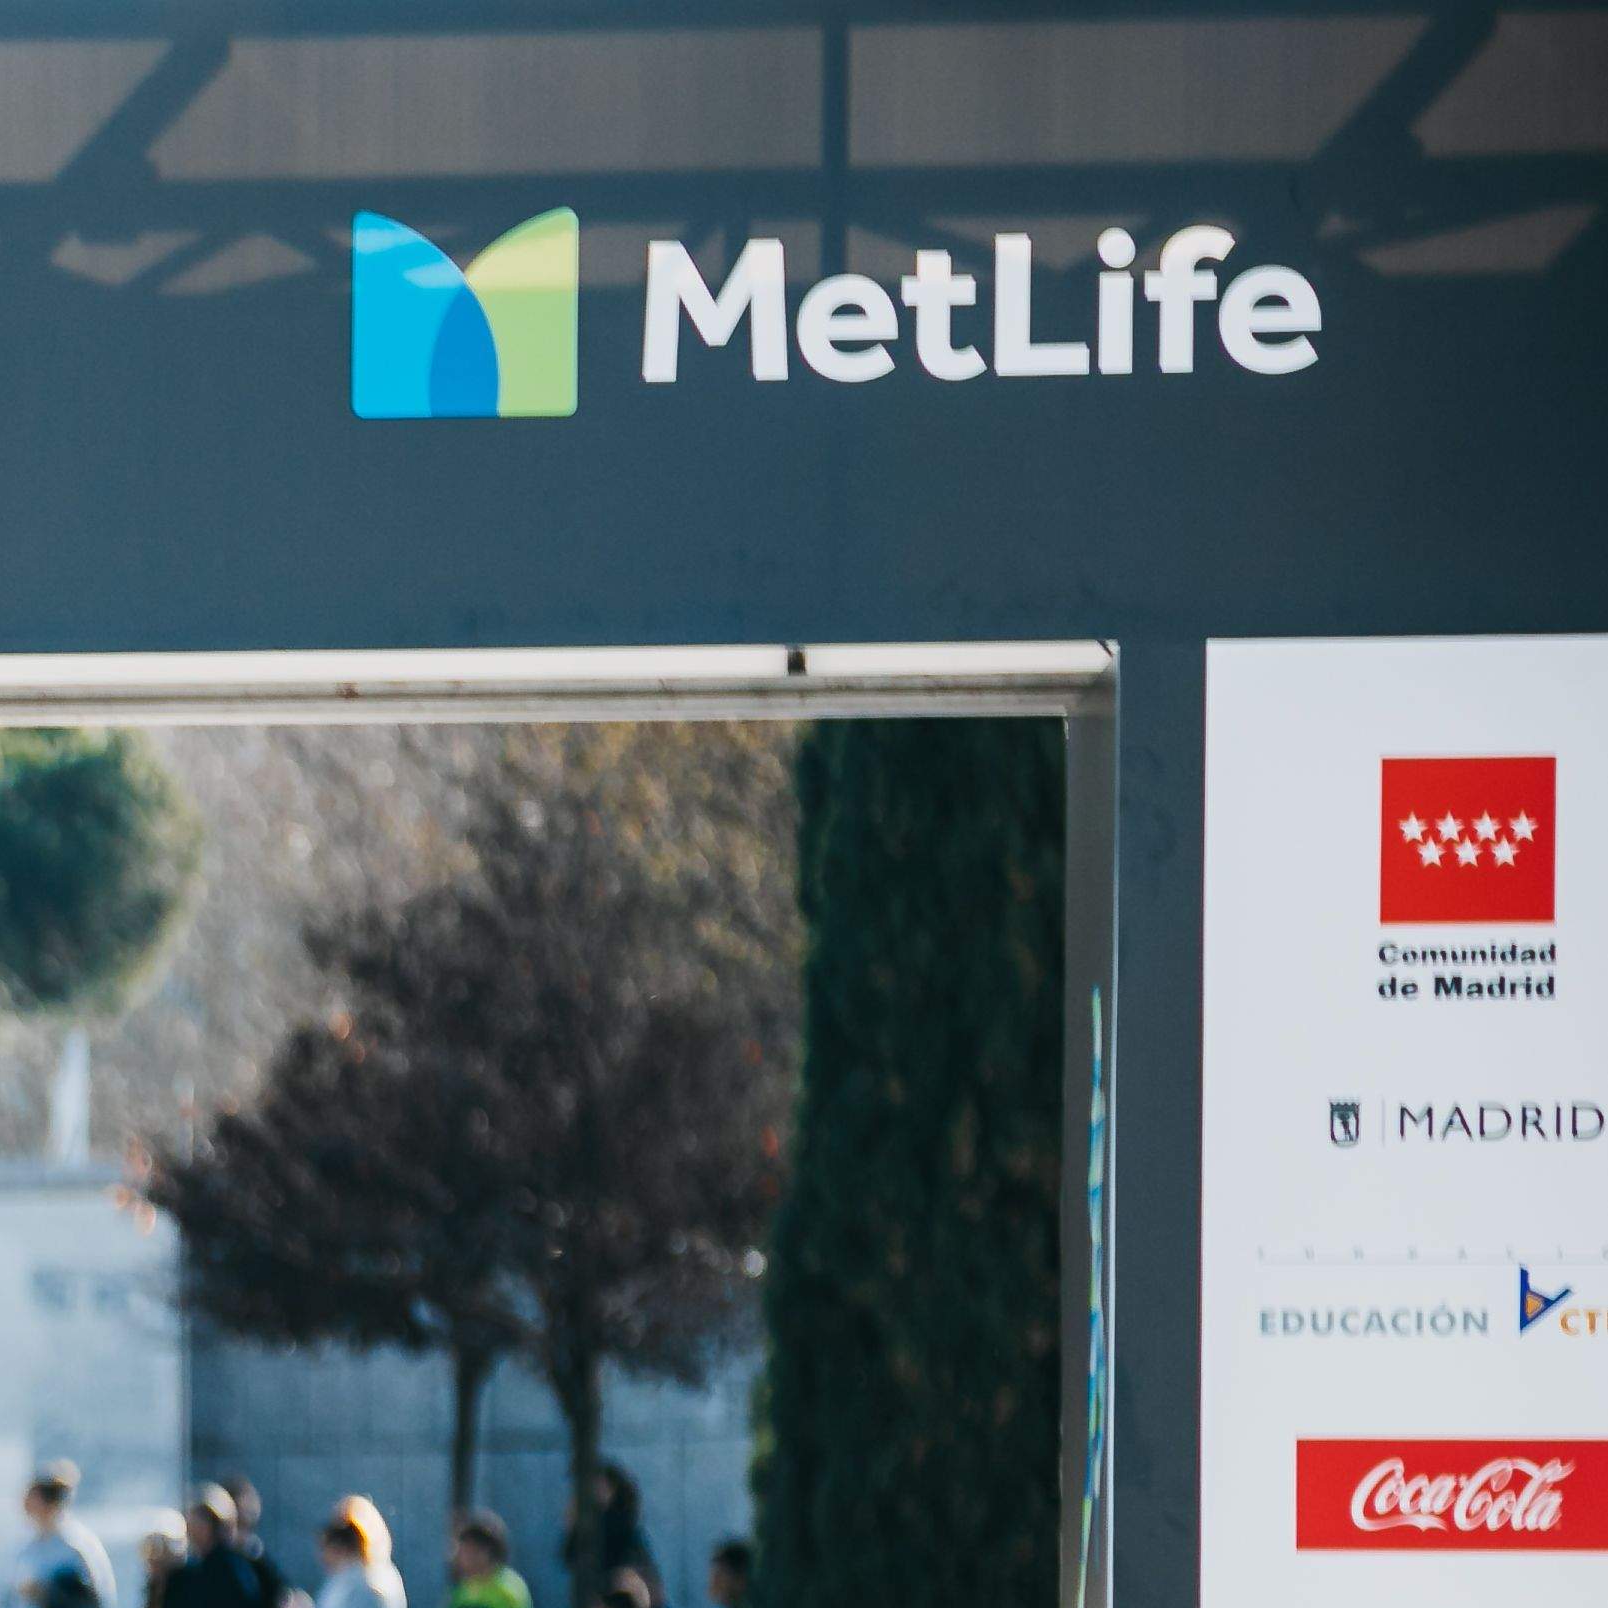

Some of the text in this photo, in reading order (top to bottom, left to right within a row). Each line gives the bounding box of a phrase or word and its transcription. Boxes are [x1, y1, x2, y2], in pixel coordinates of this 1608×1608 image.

[641, 225, 1324, 385] MetLife
[1378, 940, 1557, 967] Comunidad
[1378, 974, 1557, 1000] de Madrid
[1398, 1101, 1606, 1142] MADRID
[1258, 1301, 1490, 1336] EDUCACIÓN
[1351, 1456, 1576, 1533] Coca-Cola
